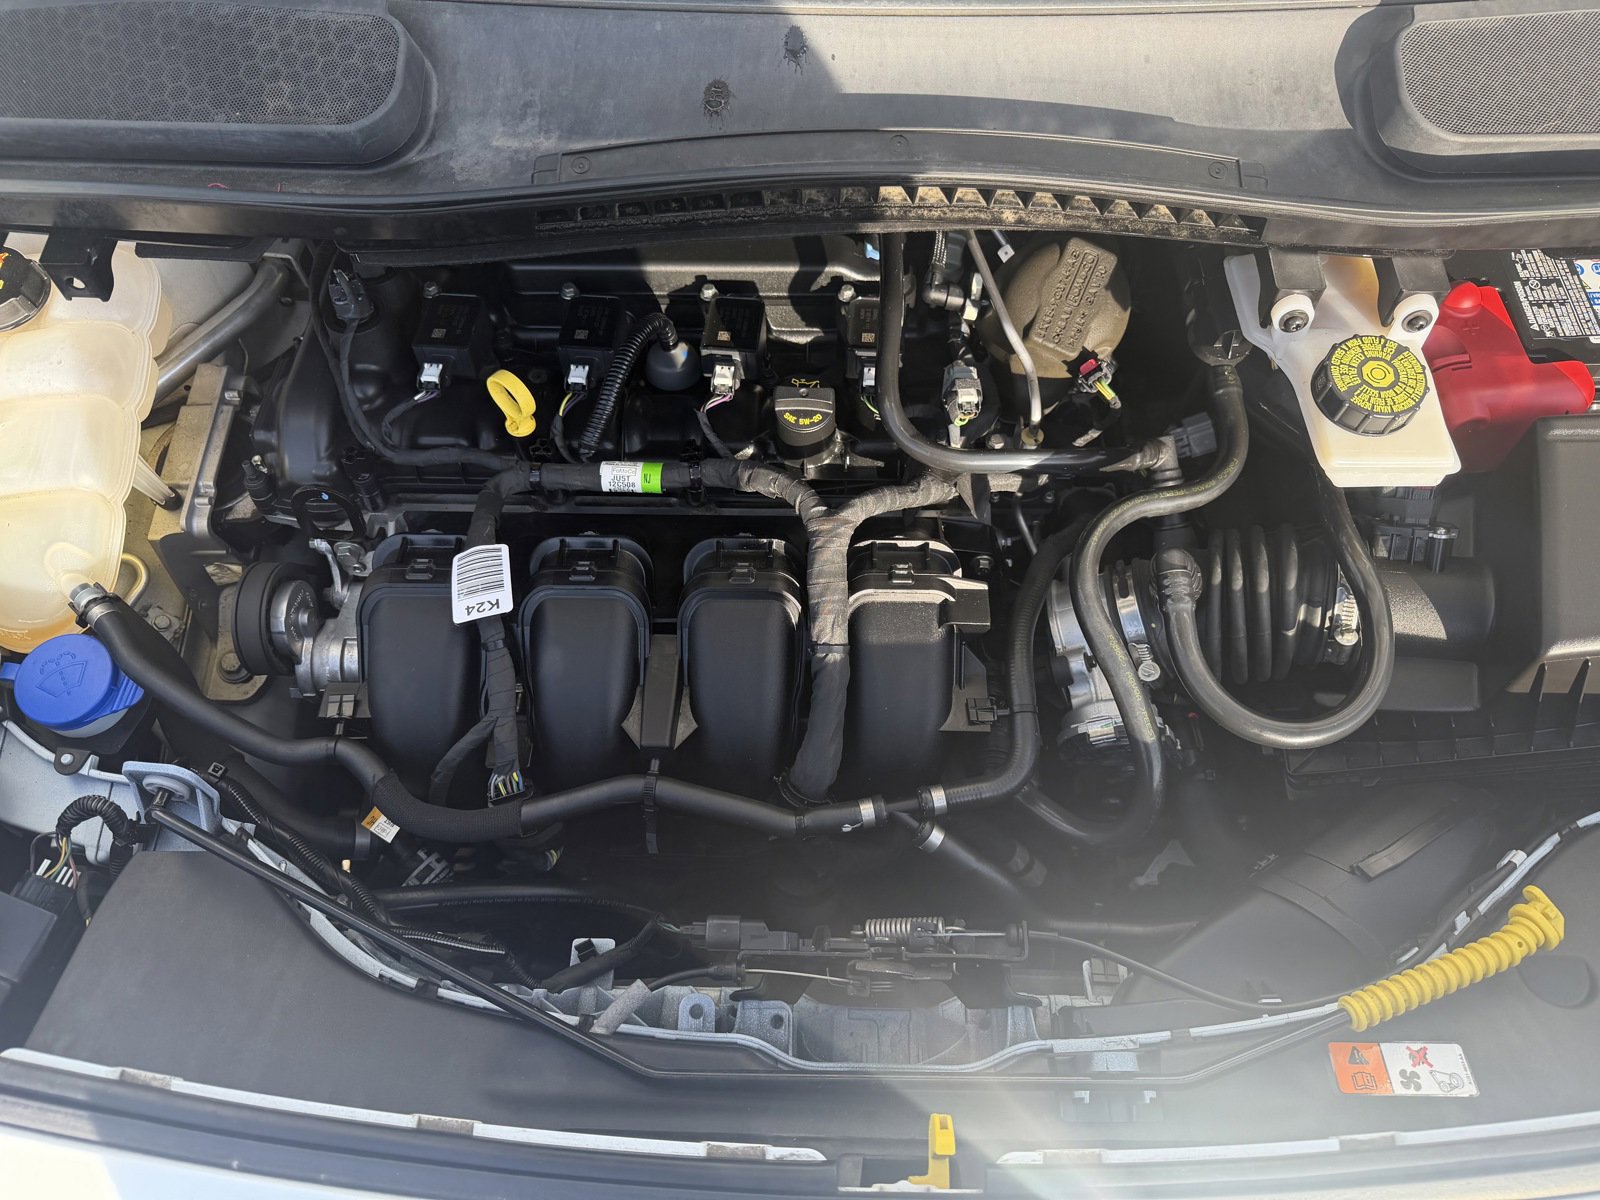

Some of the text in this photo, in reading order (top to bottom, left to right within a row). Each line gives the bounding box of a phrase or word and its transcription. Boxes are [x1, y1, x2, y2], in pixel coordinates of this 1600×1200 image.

[784, 412, 823, 426] SAE 5W-20
[643, 473, 652, 484] NJ
[465, 598, 501, 617] K24
